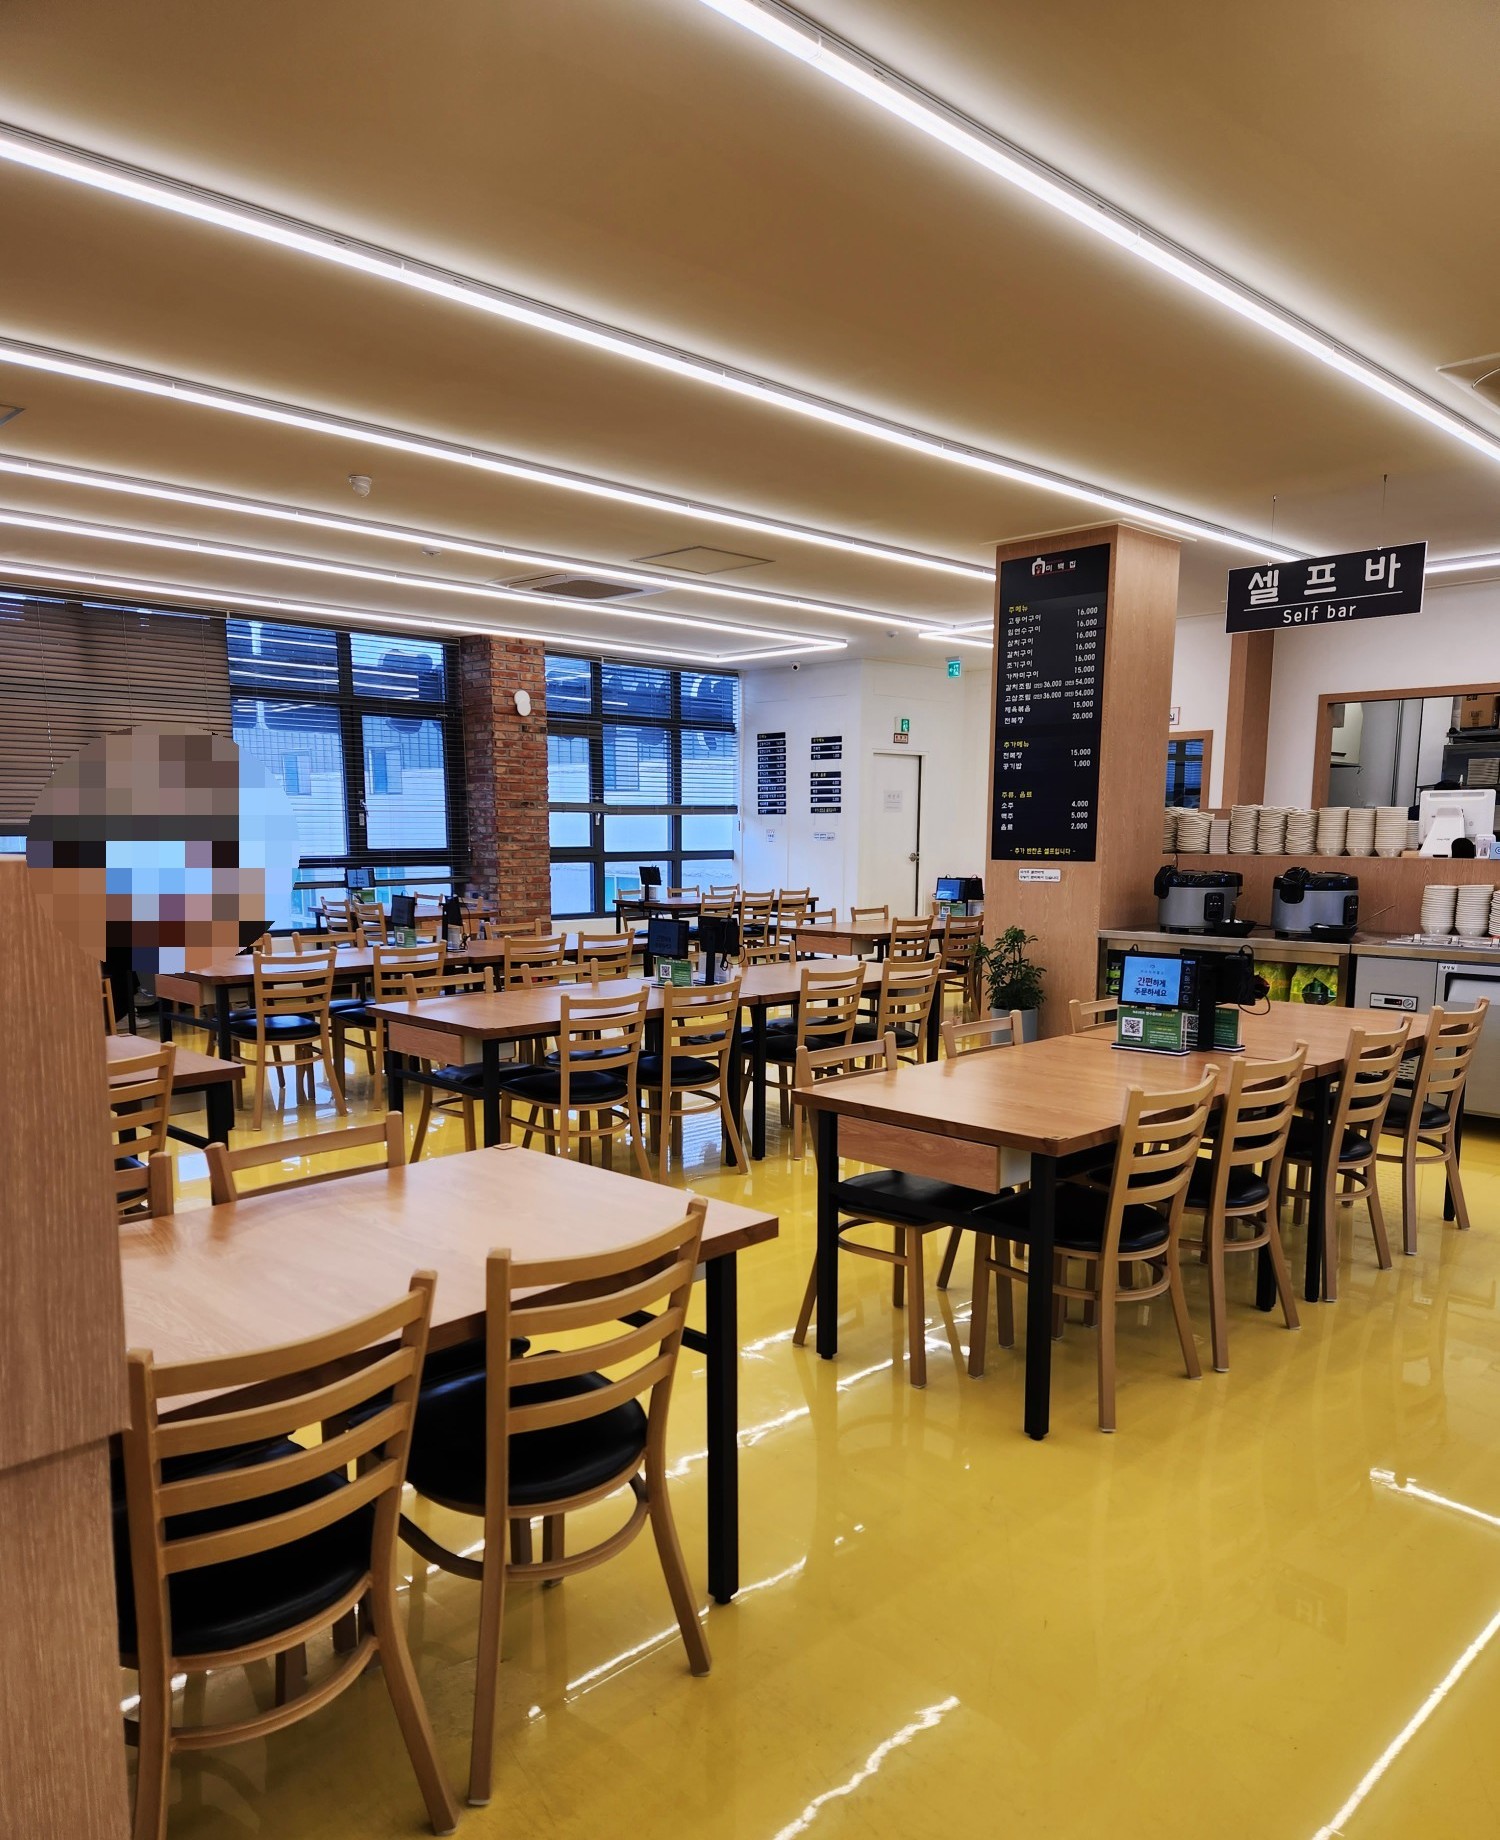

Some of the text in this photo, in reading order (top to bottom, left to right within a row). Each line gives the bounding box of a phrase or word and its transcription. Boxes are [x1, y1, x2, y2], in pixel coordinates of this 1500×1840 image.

[1008, 605, 1028, 613] 주메뉴
[1283, 604, 1357, 624] Self bar
[1008, 614, 1041, 625] 고등어구이
[1007, 626, 1041, 636] 임연수구이
[1007, 638, 1034, 647] 삼치구이
[1007, 649, 1033, 659] 갈치구이
[1006, 660, 1033, 669] 조기구이
[1006, 671, 1039, 680] 가자미구이
[1005, 682, 1032, 692] 갈치조림
[1004, 705, 1031, 714] 제육볶음
[1004, 716, 1024, 725] 전복장
[1003, 741, 1029, 749] 추가메뉴
[1003, 762, 1022, 770] 공기밥
[1137, 977, 1166, 987] 간편하게
[1134, 988, 1167, 997] 주문하세요
